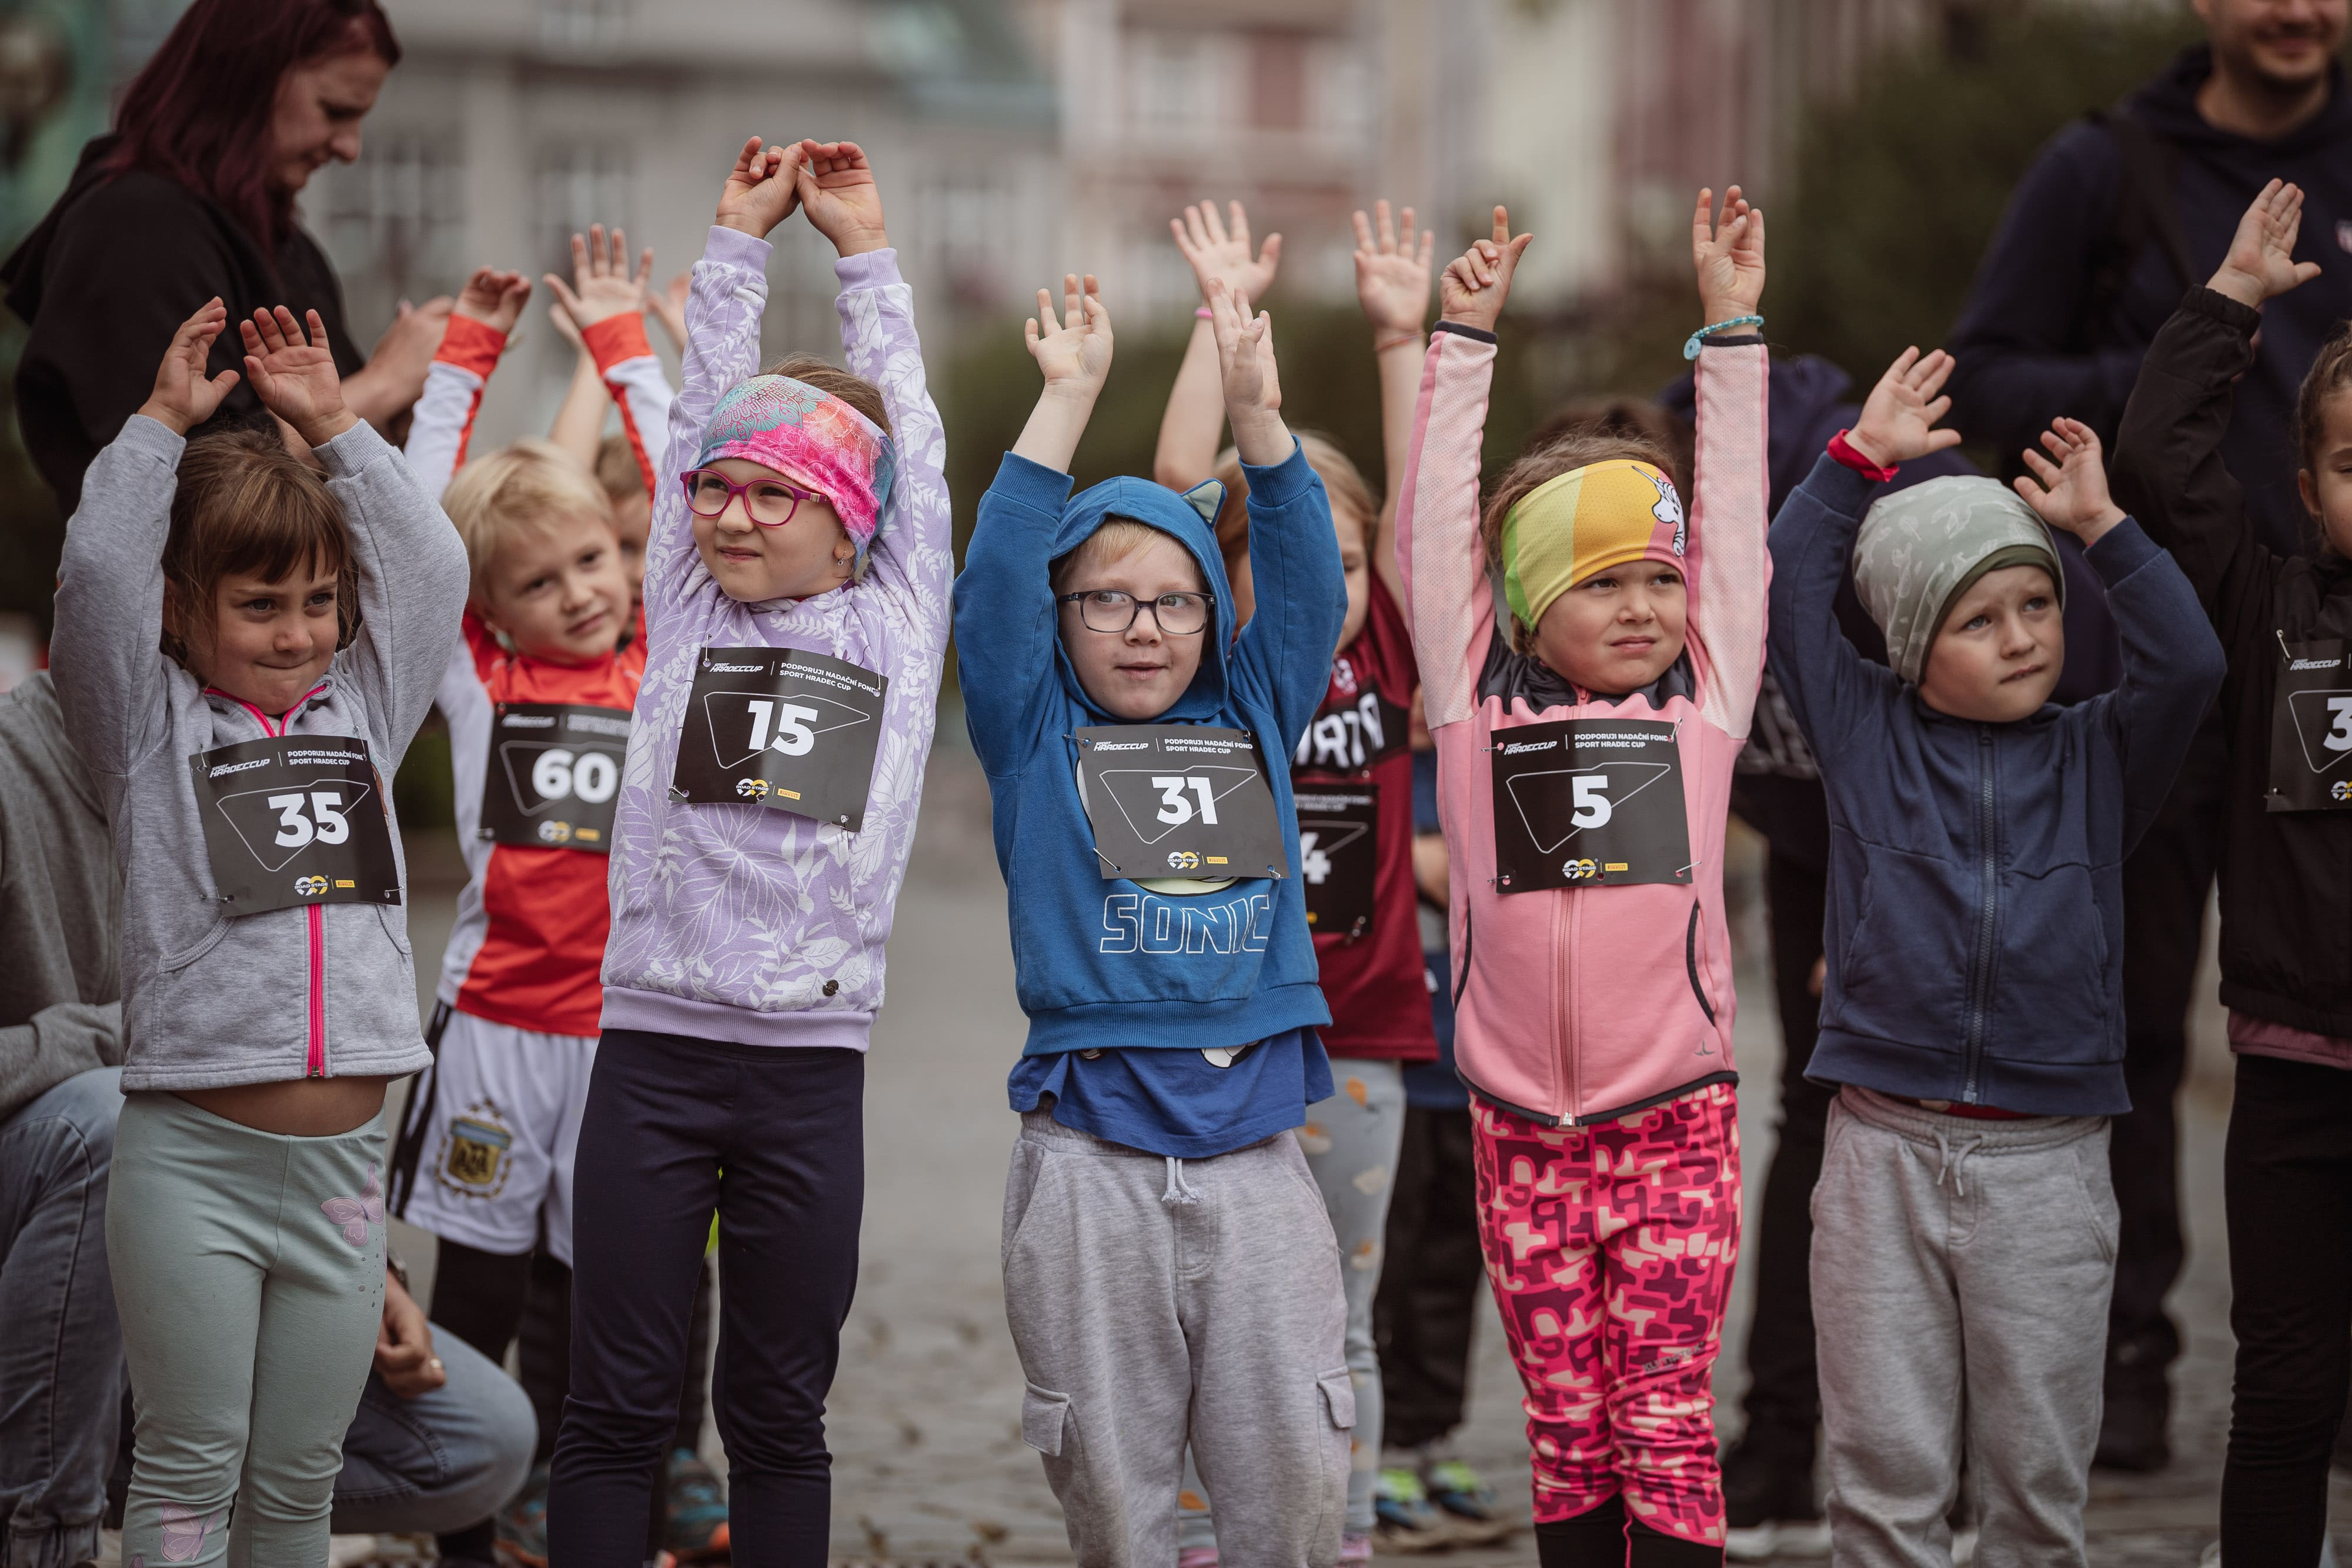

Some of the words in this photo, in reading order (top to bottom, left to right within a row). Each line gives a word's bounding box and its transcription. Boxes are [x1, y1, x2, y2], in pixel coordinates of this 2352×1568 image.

[780, 670, 804, 679] SPORT
[806, 674, 836, 687] HRADEC
[837, 682, 851, 691] CUP
[781, 662, 824, 676] PODPORUJI
[826, 671, 858, 687] NADAČNÍ
[857, 682, 876, 693] FOND
[747, 700, 818, 756] 15
[1204, 740, 1234, 748] NADAČNÍ
[1294, 693, 1385, 768] RTA
[1618, 733, 1649, 741] NADAČNÍ
[2323, 697, 2352, 751] 3
[326, 750, 352, 758] NADAČNÍ
[532, 748, 618, 804] 60
[268, 792, 349, 847] 35
[1151, 776, 1218, 825] 31
[1571, 775, 1612, 829] 5
[1100, 894, 1269, 954] SONIC
